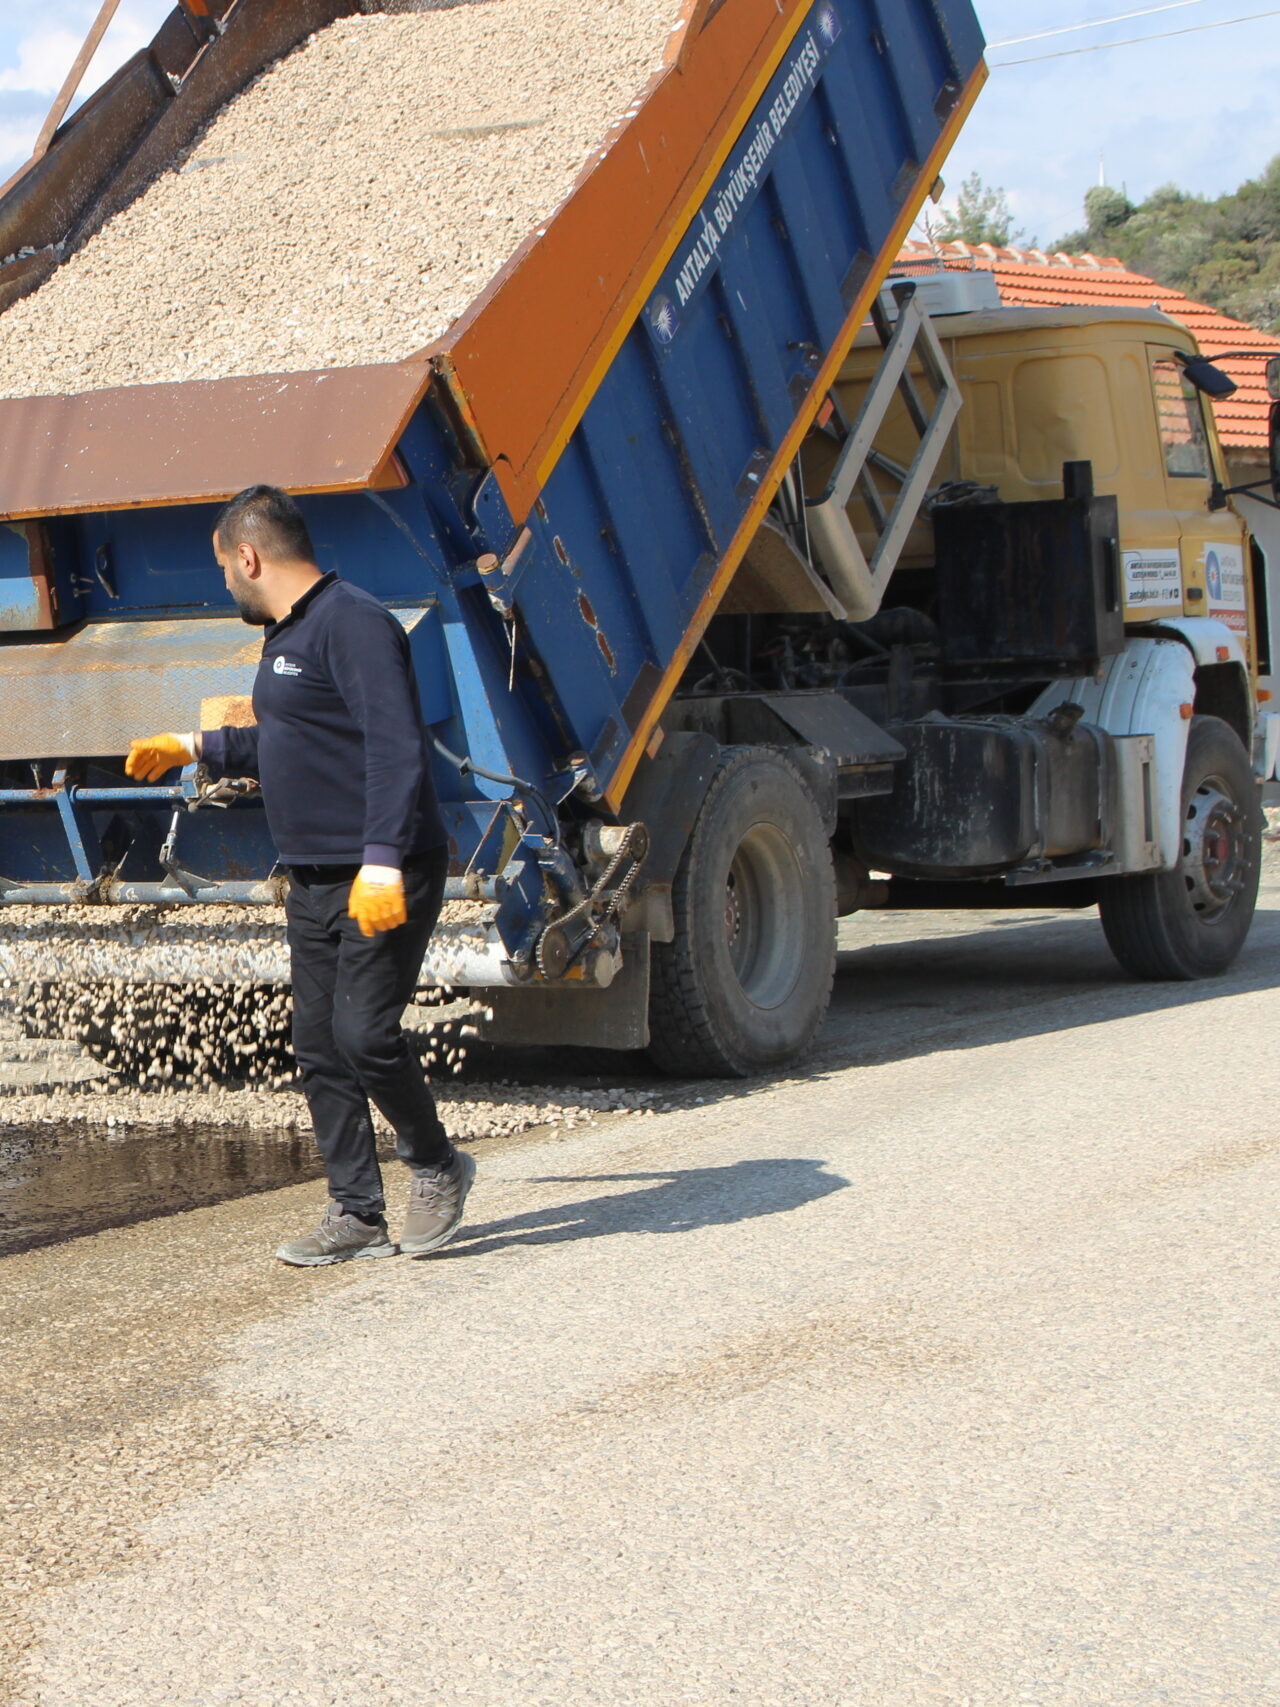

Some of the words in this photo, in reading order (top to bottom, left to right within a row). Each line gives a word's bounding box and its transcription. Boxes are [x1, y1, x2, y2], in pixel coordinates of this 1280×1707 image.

[675, 221, 721, 307] ANTALYA
[714, 121, 775, 235] BÜYÜKŞEHİR
[769, 30, 820, 136] BELEDİYESİ
